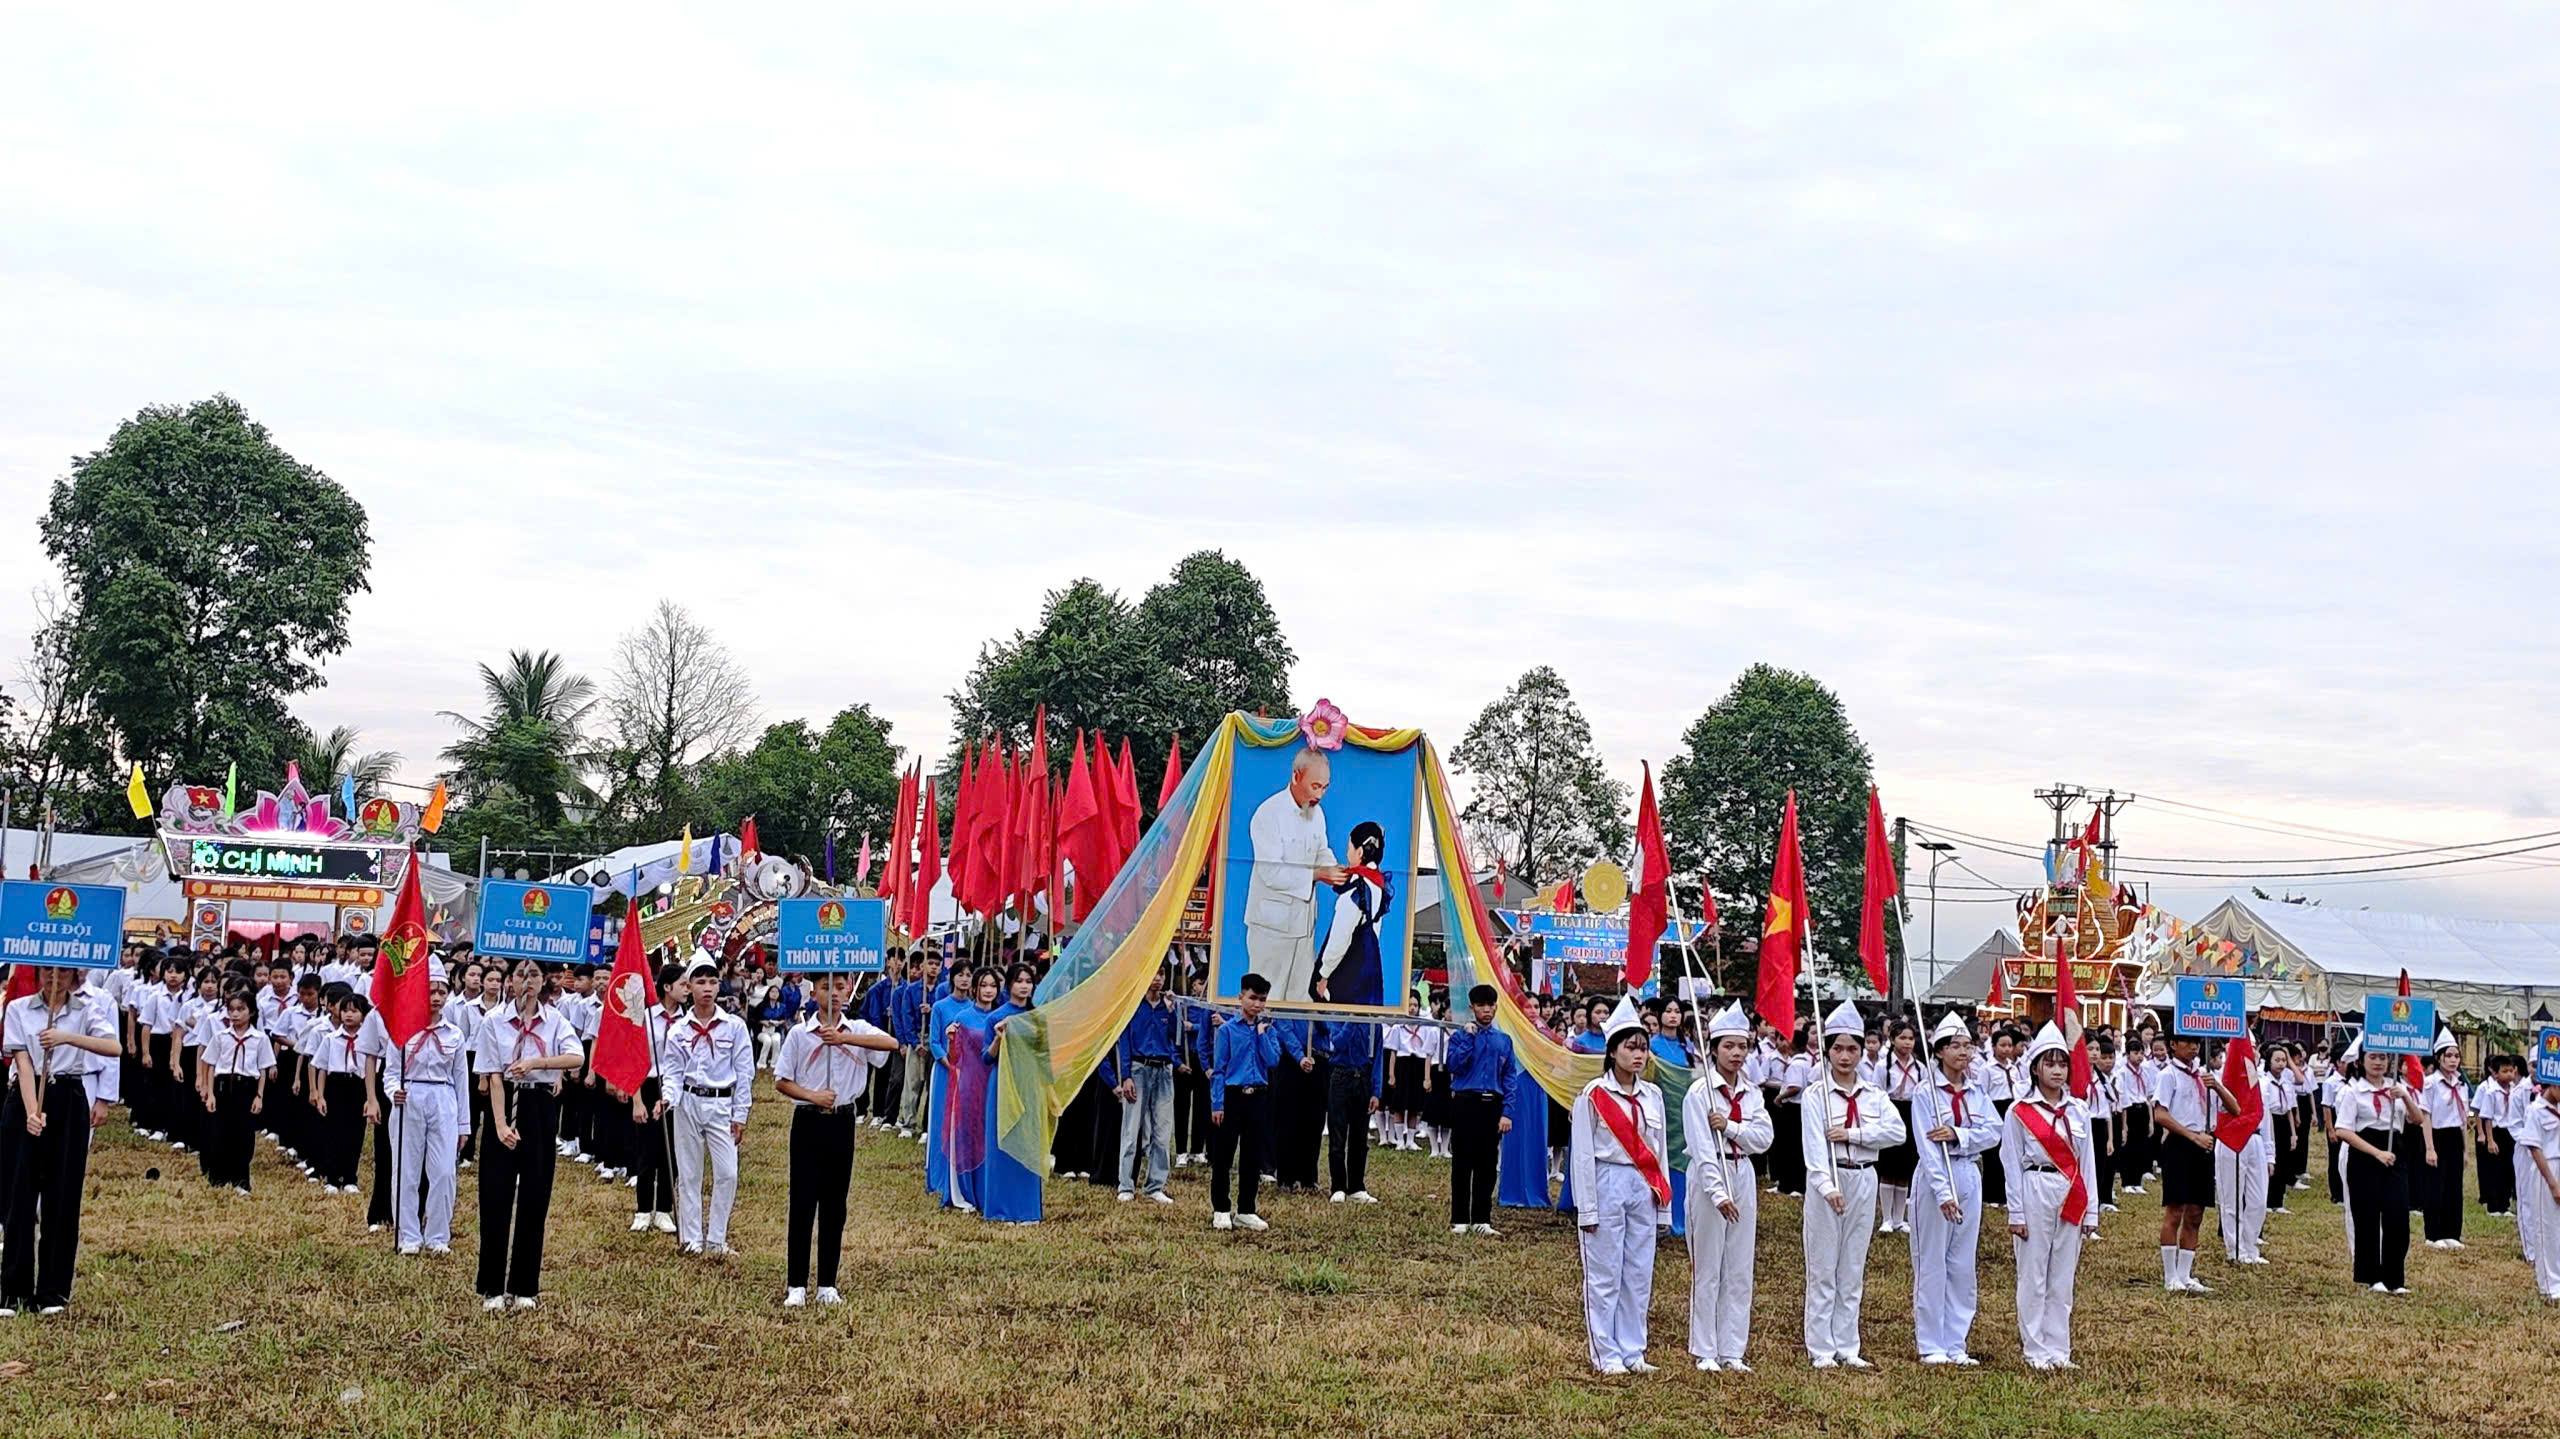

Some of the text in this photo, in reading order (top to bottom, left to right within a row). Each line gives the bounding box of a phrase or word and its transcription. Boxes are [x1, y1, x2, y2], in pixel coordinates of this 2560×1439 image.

[222, 849, 263, 873] CHÍ
[266, 850, 324, 874] MINH
[27, 921, 92, 938] CHI ĐỘI
[504, 918, 563, 932] CHI ĐỘI
[484, 930, 516, 949] THÔN
[519, 932, 543, 952] YÊN
[545, 935, 577, 955] THÔN
[805, 932, 859, 946] CHI ĐỘI
[3, 935, 112, 961] THÔN DUYÊN HY
[785, 946, 879, 968] THÔN VỆ THÔN
[2073, 965, 2093, 979] 2026
[2190, 1000, 2210, 1010] CHI
[2382, 1023, 2418, 1034] CHI ĐỘI
